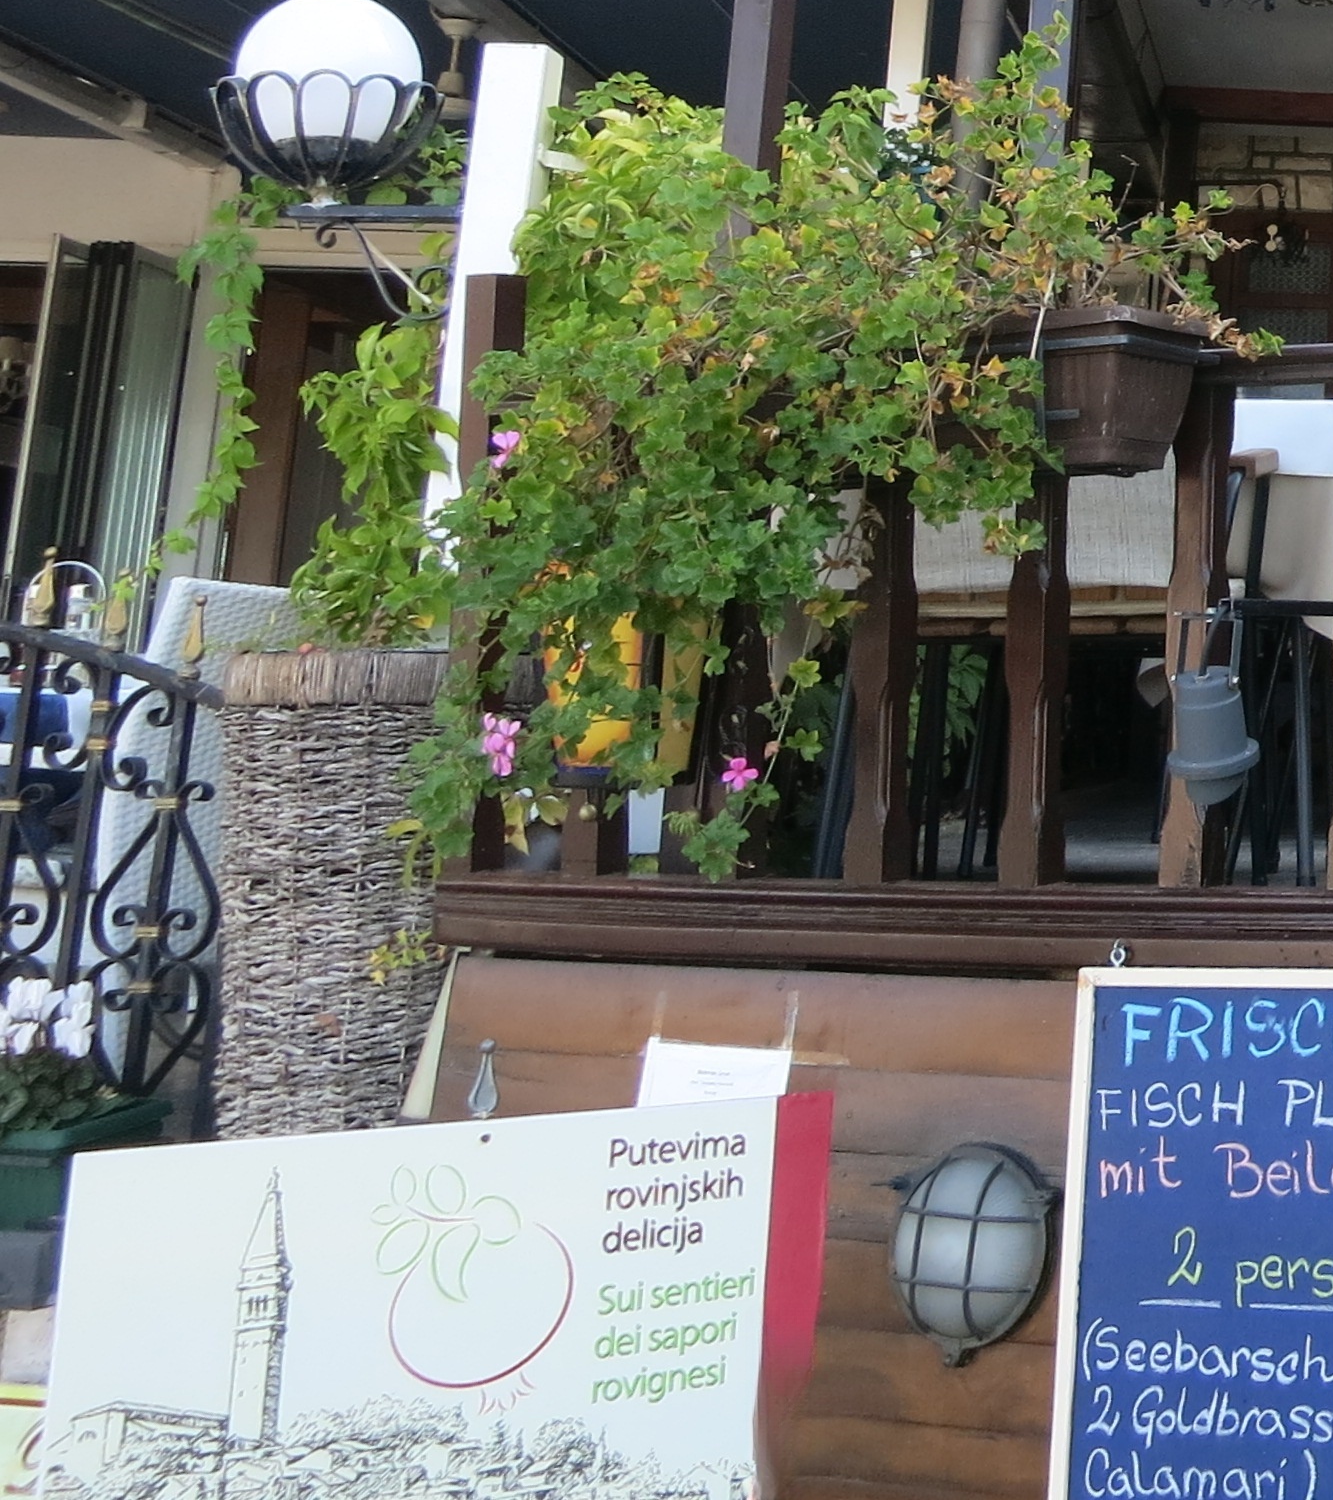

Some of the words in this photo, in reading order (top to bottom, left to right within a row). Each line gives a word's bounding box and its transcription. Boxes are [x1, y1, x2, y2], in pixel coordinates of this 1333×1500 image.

[1097, 1080, 1246, 1130] FISCH
[608, 1131, 747, 1168] Putevima
[1099, 1136, 1183, 1199] mit
[605, 1167, 744, 1212] rovinjskih
[601, 1216, 704, 1255] delicija
[1166, 1226, 1203, 1287] 2
[597, 1280, 645, 1316] Sui
[650, 1267, 757, 1309] sentieri
[594, 1324, 642, 1360] dei
[648, 1311, 738, 1356] sapori
[591, 1354, 727, 1404] rovignesi
[1086, 1384, 1120, 1437] 2
